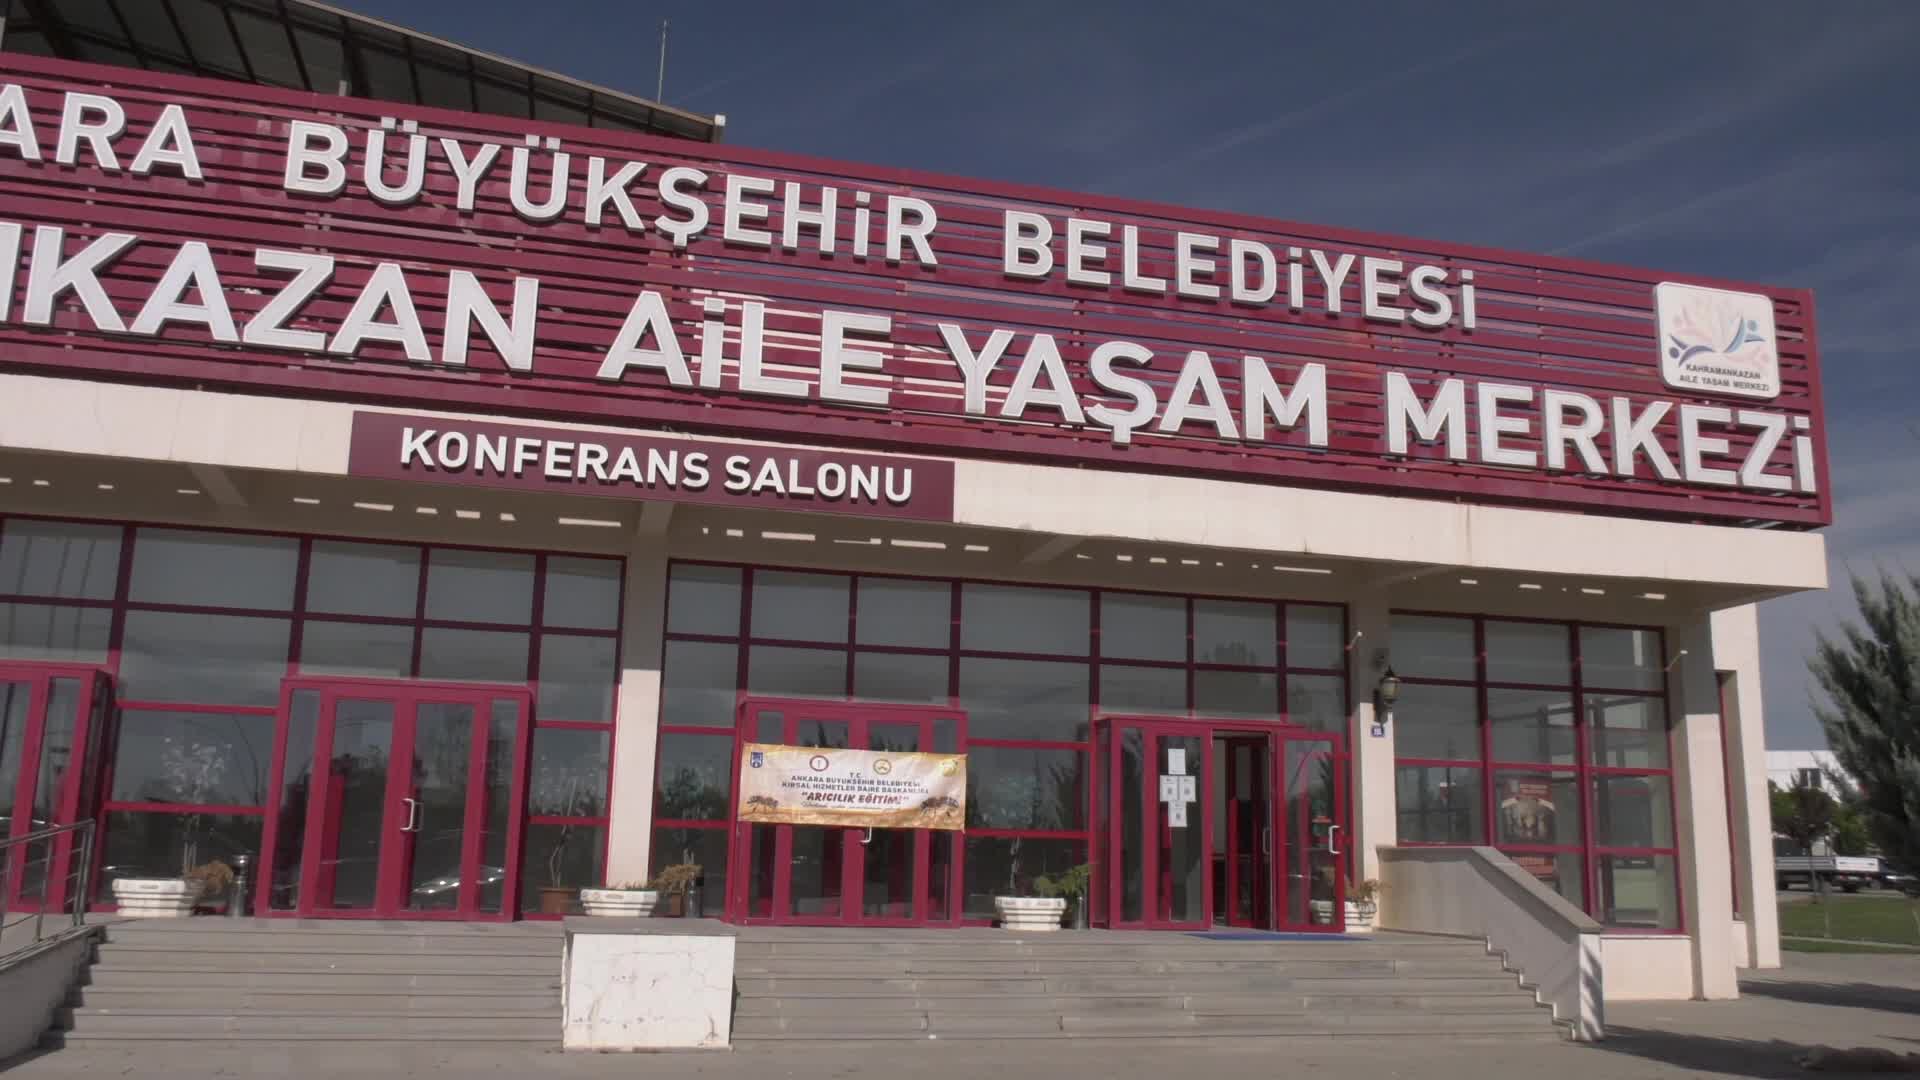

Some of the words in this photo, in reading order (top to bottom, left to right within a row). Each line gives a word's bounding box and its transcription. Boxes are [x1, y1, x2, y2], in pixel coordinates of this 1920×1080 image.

[0, 221, 539, 372] KAZAN
[937, 322, 1328, 447] YAŞAM
[400, 426, 711, 488] KONFERANS
[723, 454, 912, 502] SALONU
